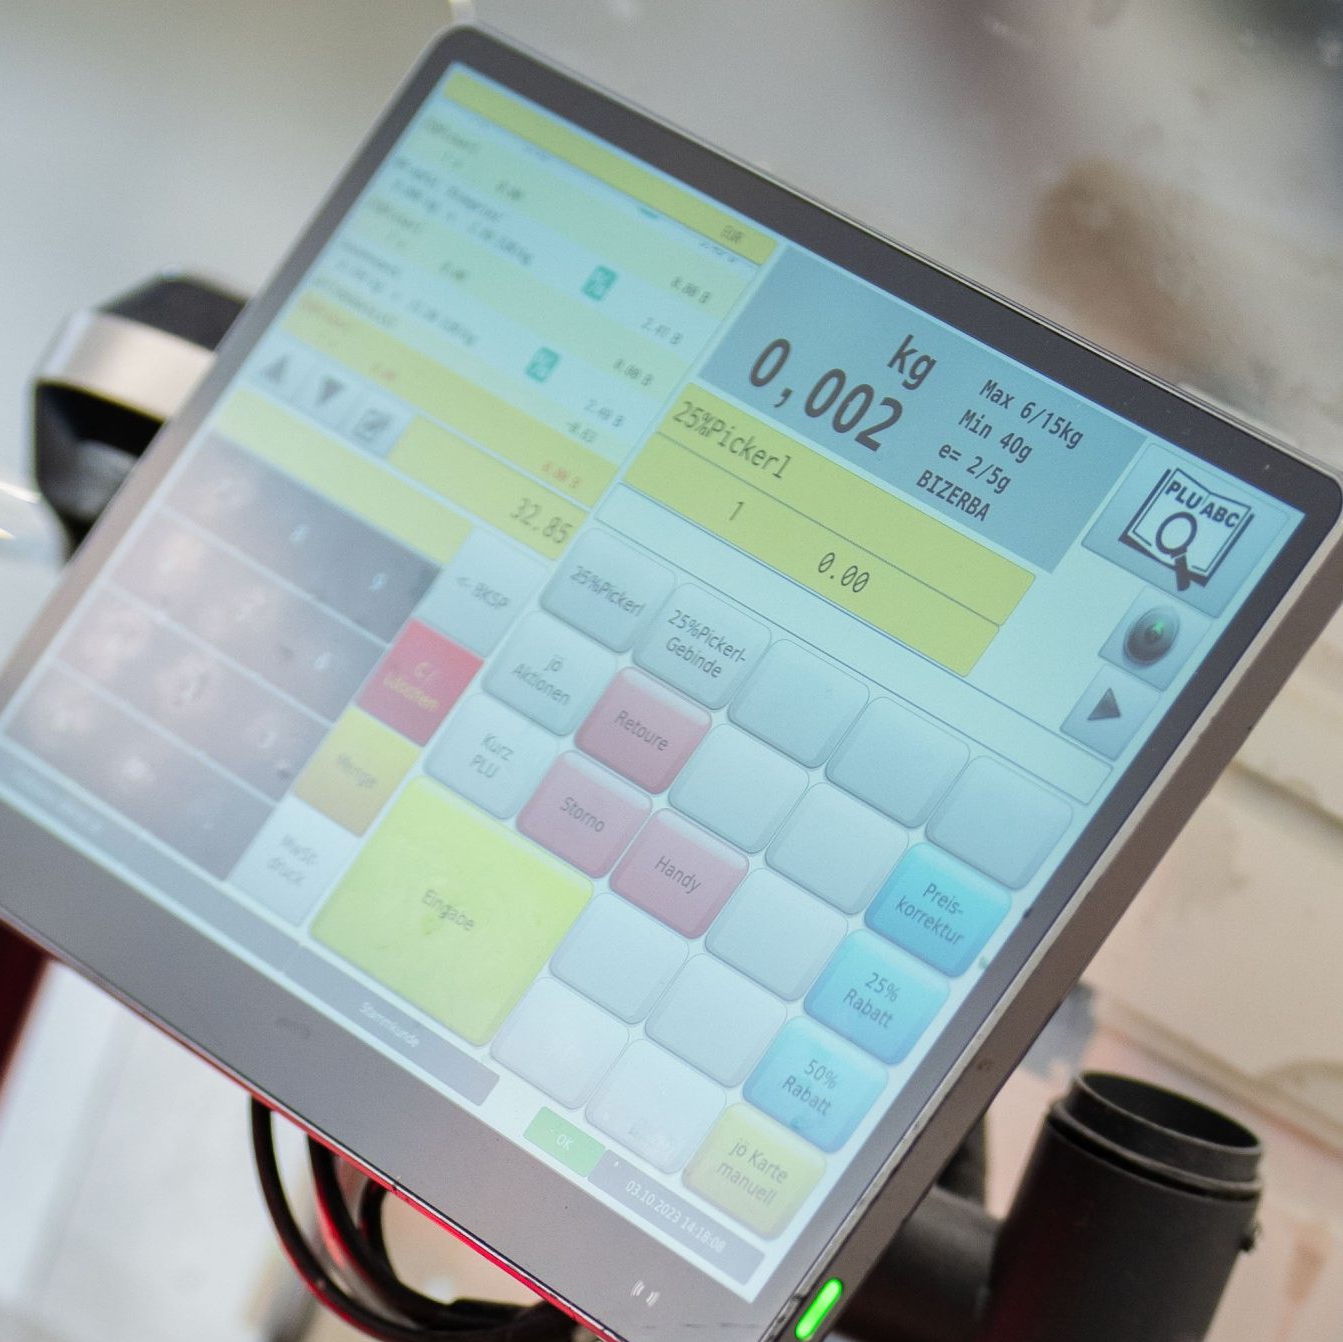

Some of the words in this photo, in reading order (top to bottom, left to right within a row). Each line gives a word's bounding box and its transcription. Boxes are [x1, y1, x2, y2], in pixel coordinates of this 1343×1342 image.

[886, 333, 937, 391] kg
[748, 337, 903, 452] 0,002
[978, 378, 1015, 409] Max
[1019, 400, 1084, 450] 6/15kg
[957, 408, 993, 439] Min
[998, 431, 1033, 464] 40g
[937, 443, 962, 461] e=
[965, 455, 1011, 494] 2/5g
[915, 468, 991, 521] BIZERBA
[1164, 479, 1203, 510] PLU
[1198, 501, 1240, 529] ABC
[509, 496, 574, 545] 32.85
[569, 564, 646, 617] 25%Pickerl
[817, 551, 870, 593] 0.00
[665, 635, 722, 678] Gebinde
[666, 608, 749, 662] 25%Pickerl-
[510, 662, 571, 706] Aktionen
[480, 732, 514, 761] Kurz
[612, 709, 668, 751] Retoure
[468, 753, 500, 779] PLU
[558, 795, 605, 833] Storno
[653, 854, 702, 894] Handy
[420, 887, 475, 931] Eingabe
[894, 894, 964, 945] korrektur
[921, 881, 963, 915] Preis-
[841, 987, 893, 1029] Rabatt
[863, 971, 900, 1003] 25%
[803, 1057, 838, 1089] 50%
[781, 1074, 832, 1117] Rabatt
[555, 1133, 574, 1151] OK
[715, 1161, 778, 1207] manuell
[746, 1148, 788, 1184] Karte
[624, 1179, 682, 1223] 03.10.2023
